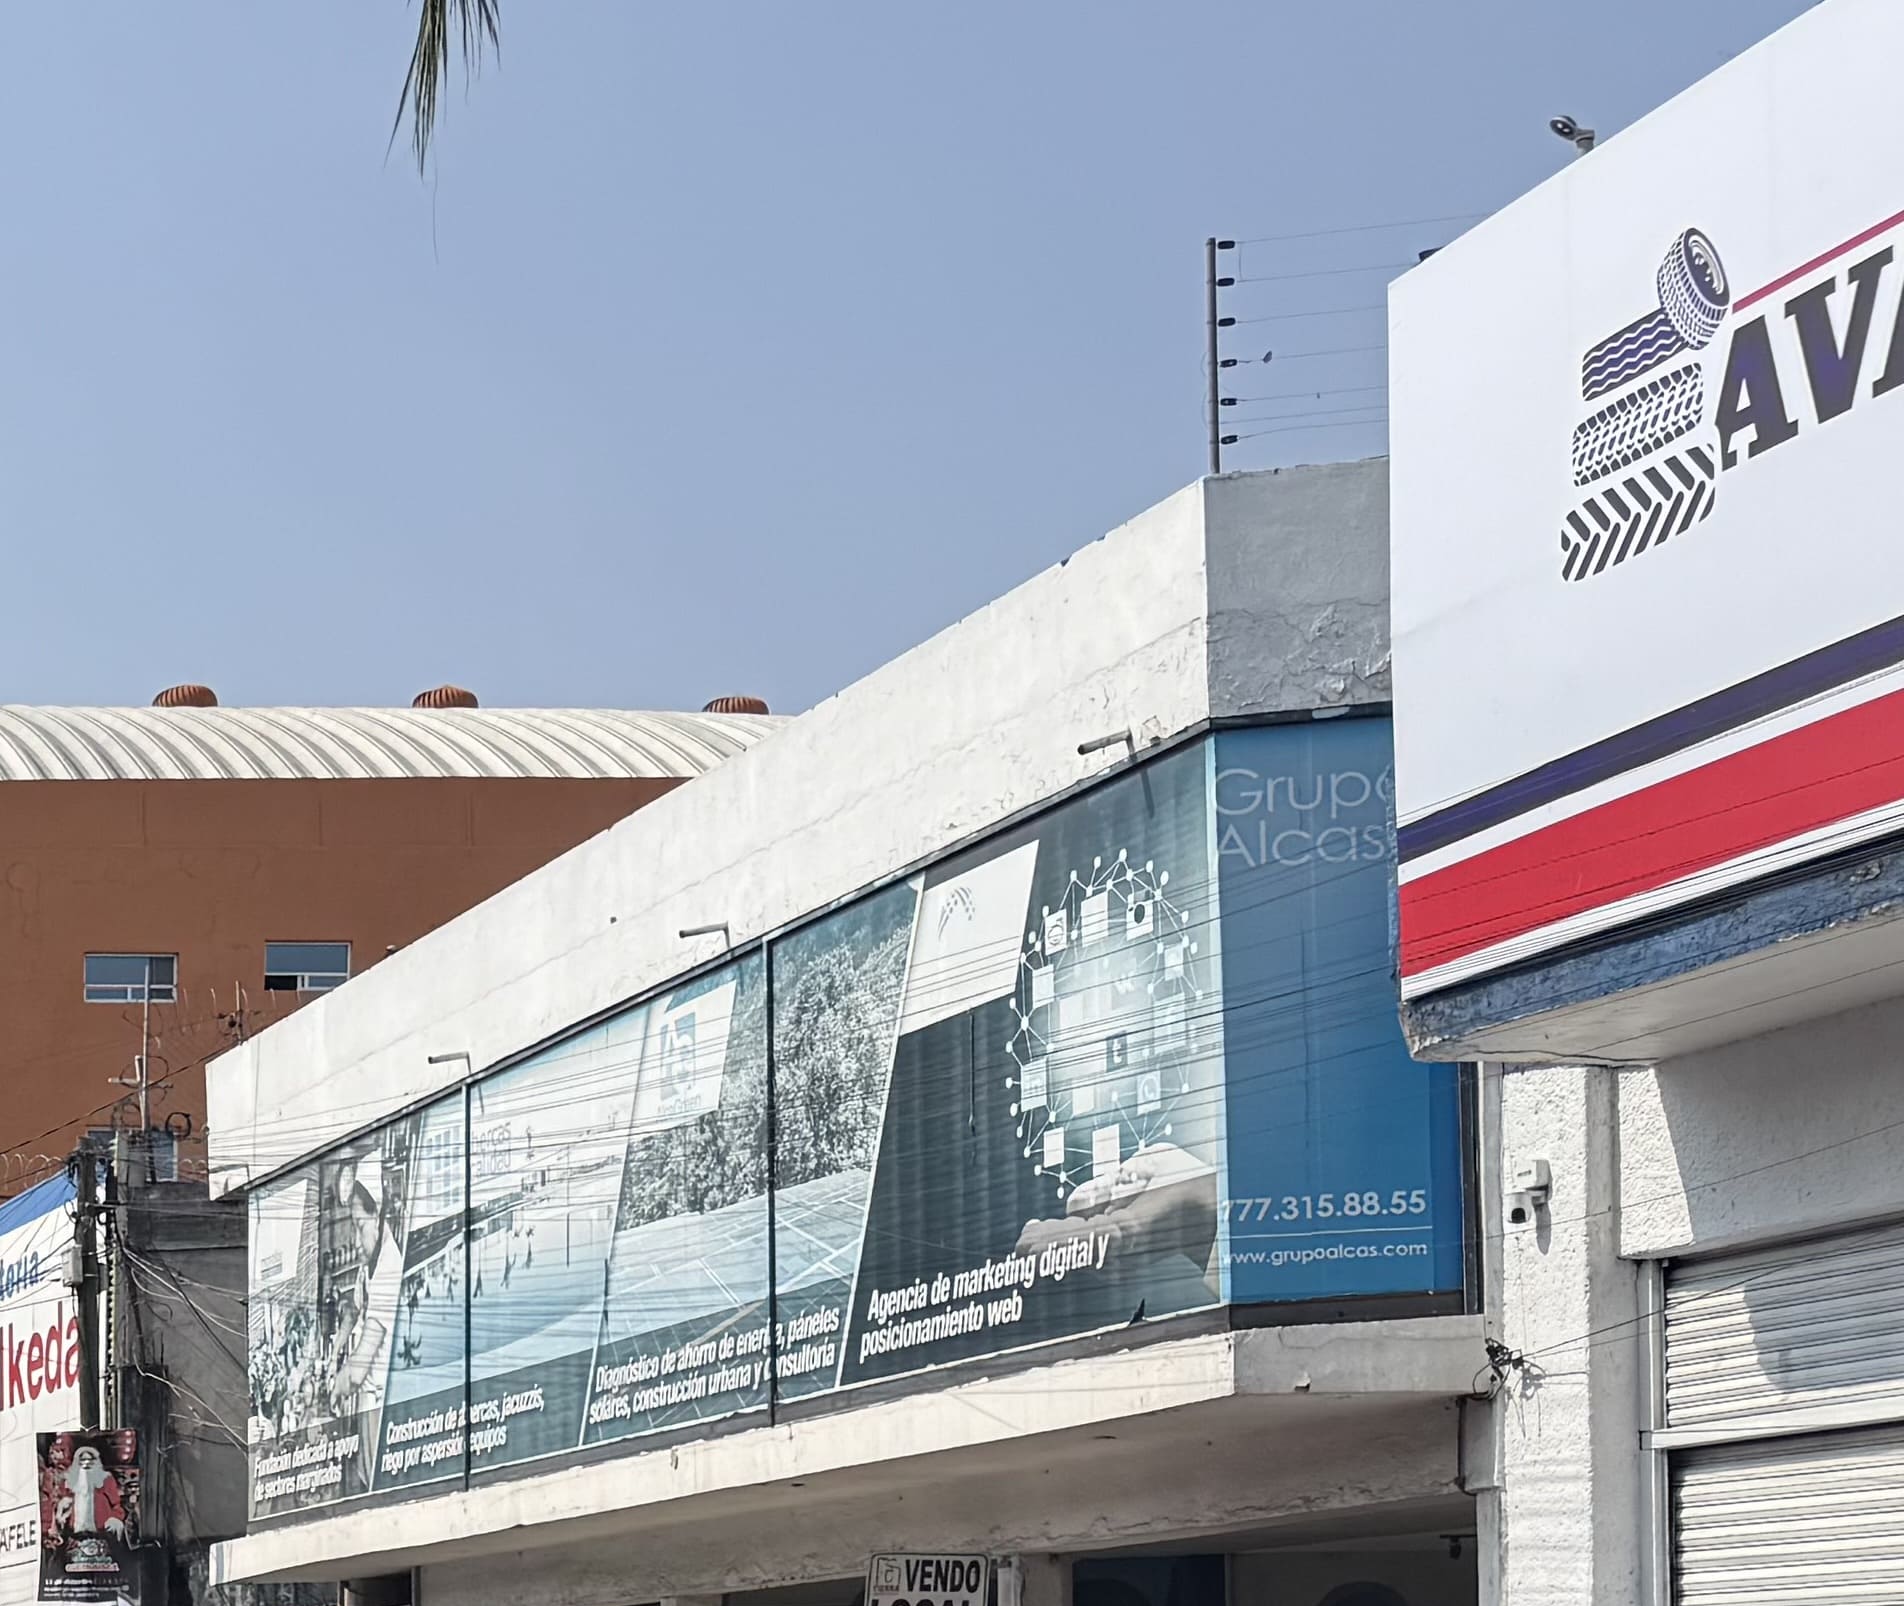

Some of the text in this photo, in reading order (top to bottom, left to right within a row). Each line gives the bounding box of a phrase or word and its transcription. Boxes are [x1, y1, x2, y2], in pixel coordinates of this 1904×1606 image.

[1218, 820, 1385, 867] Alcas
[867, 1231, 1111, 1325] Agencia de marketing digital y
[595, 1353, 660, 1394] Diagnóstico
[660, 1347, 676, 1376] de
[676, 1341, 717, 1372] ahorro
[718, 1332, 735, 1359] de
[786, 1304, 840, 1349] páneles
[859, 1289, 1023, 1364] posicionamiento web
[589, 1337, 836, 1424] solares, construcción urbana y cnsultoría
[444, 1406, 458, 1431] de
[404, 1443, 421, 1473] por
[905, 1559, 981, 1593] VENDO
